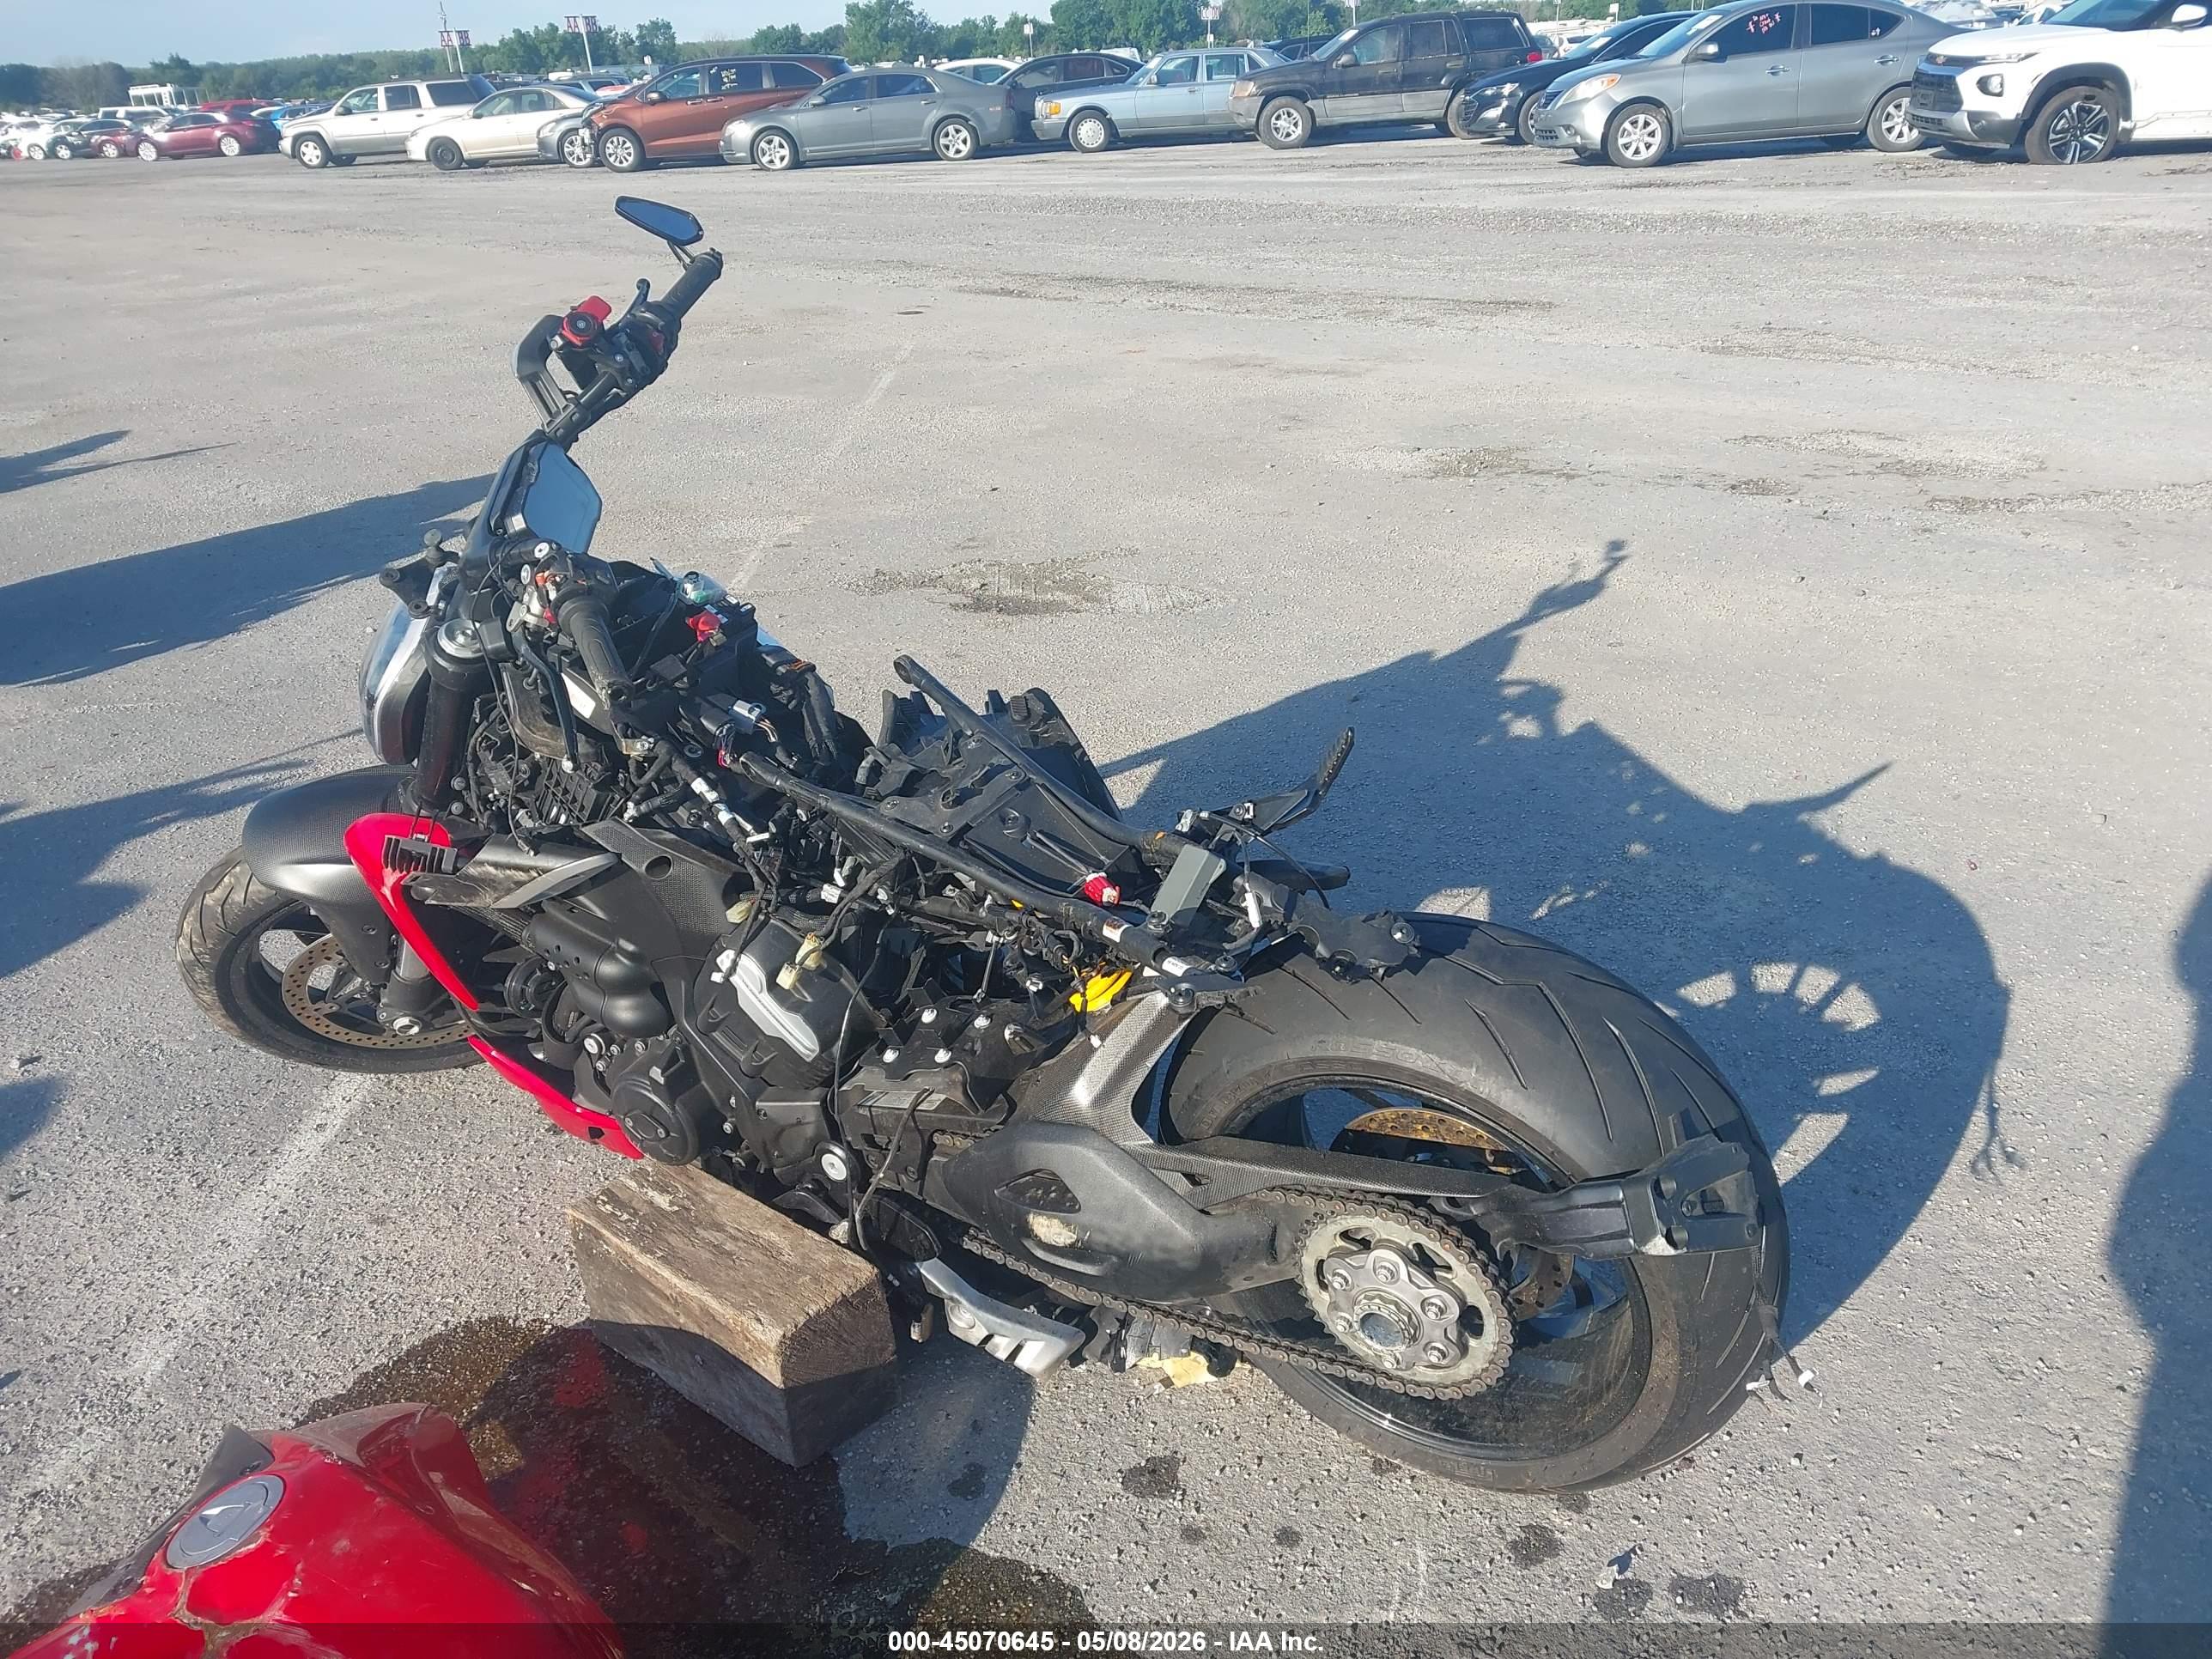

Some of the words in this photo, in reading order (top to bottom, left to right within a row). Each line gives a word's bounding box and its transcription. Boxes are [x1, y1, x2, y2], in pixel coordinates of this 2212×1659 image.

[567, 17, 580, 33] AA
[585, 17, 598, 33] BB
[441, 32, 453, 46] AA
[458, 31, 471, 46] BB
